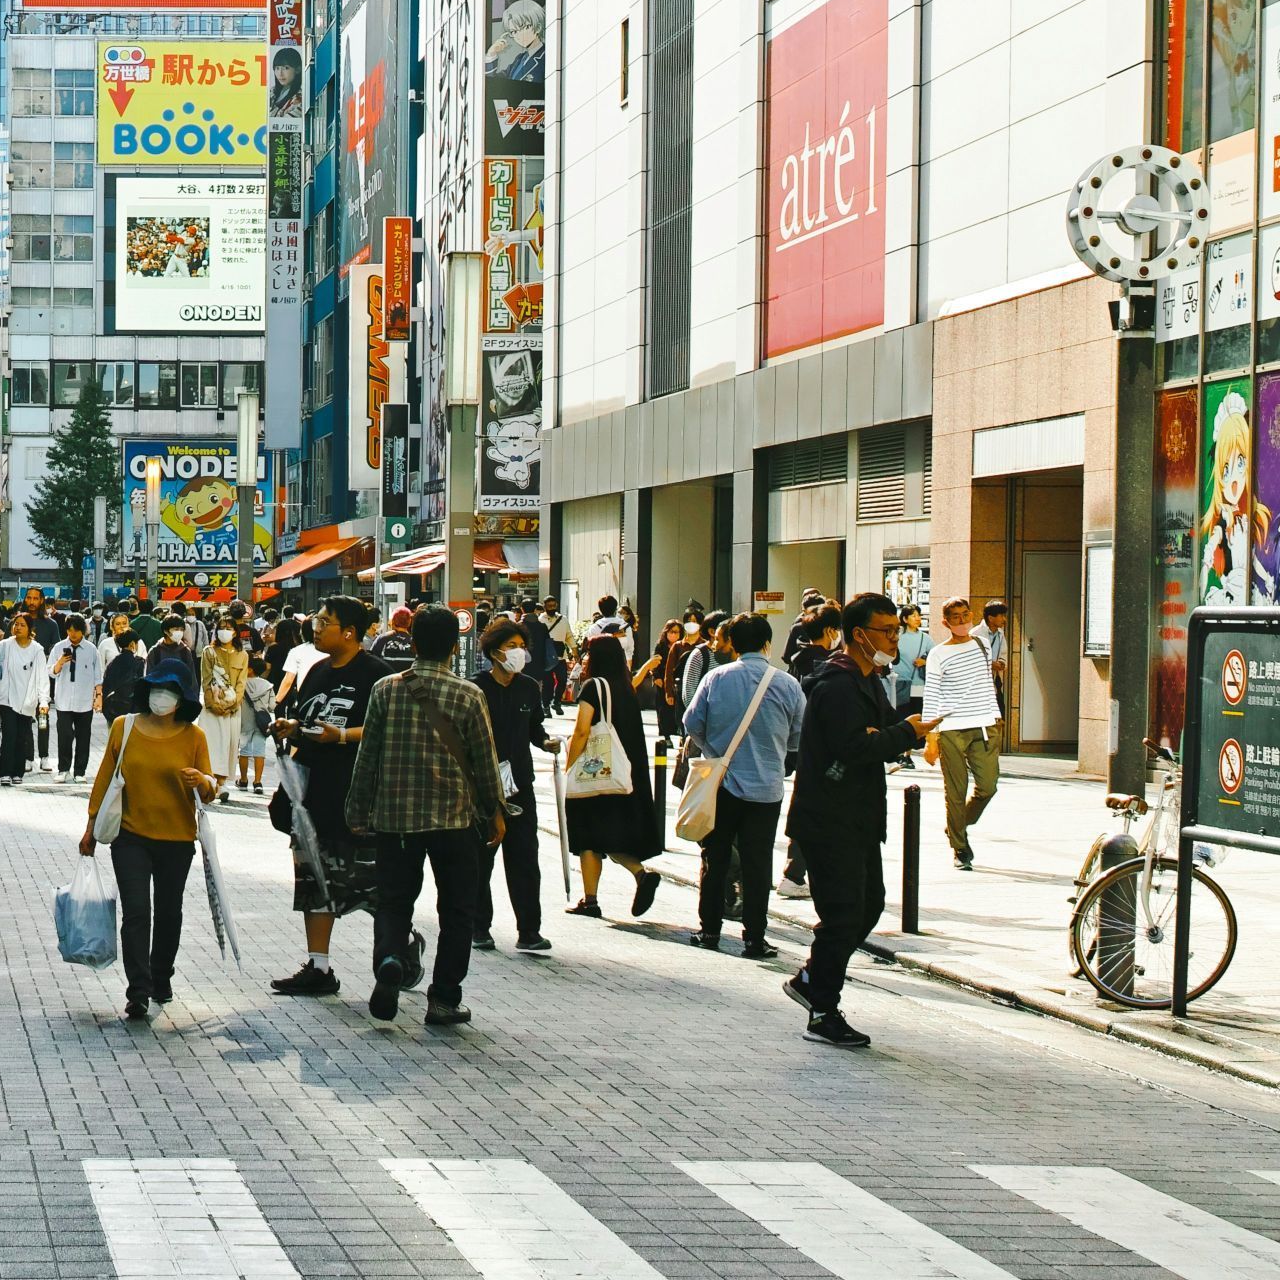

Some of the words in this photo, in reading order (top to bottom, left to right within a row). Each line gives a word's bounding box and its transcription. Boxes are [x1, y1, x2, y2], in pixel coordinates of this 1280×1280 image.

[179, 305, 262, 322] ONODEN
[167, 446, 217, 456] Welcome
[218, 447, 230, 456] to
